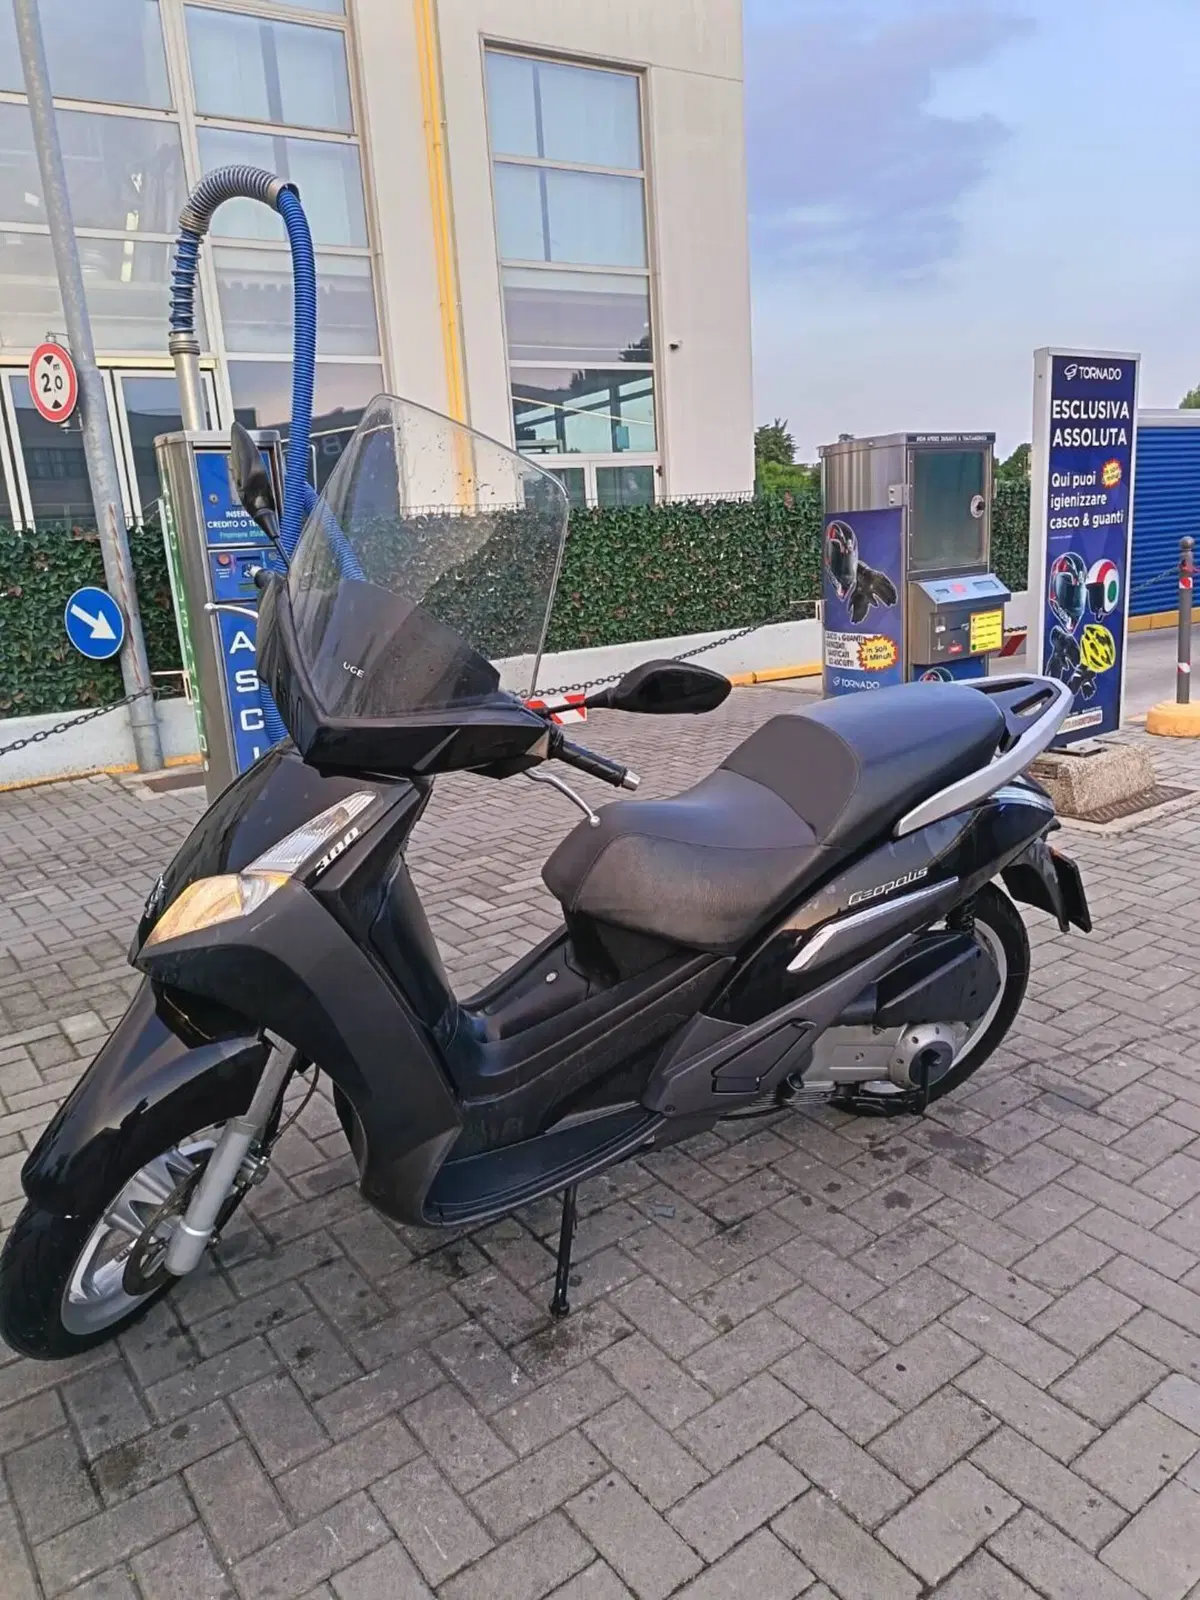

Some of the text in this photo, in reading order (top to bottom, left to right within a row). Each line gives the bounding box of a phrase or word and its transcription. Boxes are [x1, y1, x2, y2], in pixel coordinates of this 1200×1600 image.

[1079, 365, 1122, 380] TORNADO
[1052, 399, 1130, 420] ESCLUSIVA
[1052, 428, 1127, 447] ASSOLUTA
[1051, 473, 1070, 488] Qui
[1072, 471, 1096, 489] puoi
[1050, 493, 1107, 511] igienizzare
[207, 520, 239, 528] CREDITO
[240, 520, 247, 528] O
[1049, 510, 1124, 530] casco & guanti
[841, 678, 880, 690] TORNADO
[315, 827, 359, 876] 300
[848, 867, 928, 906] Geopolis
